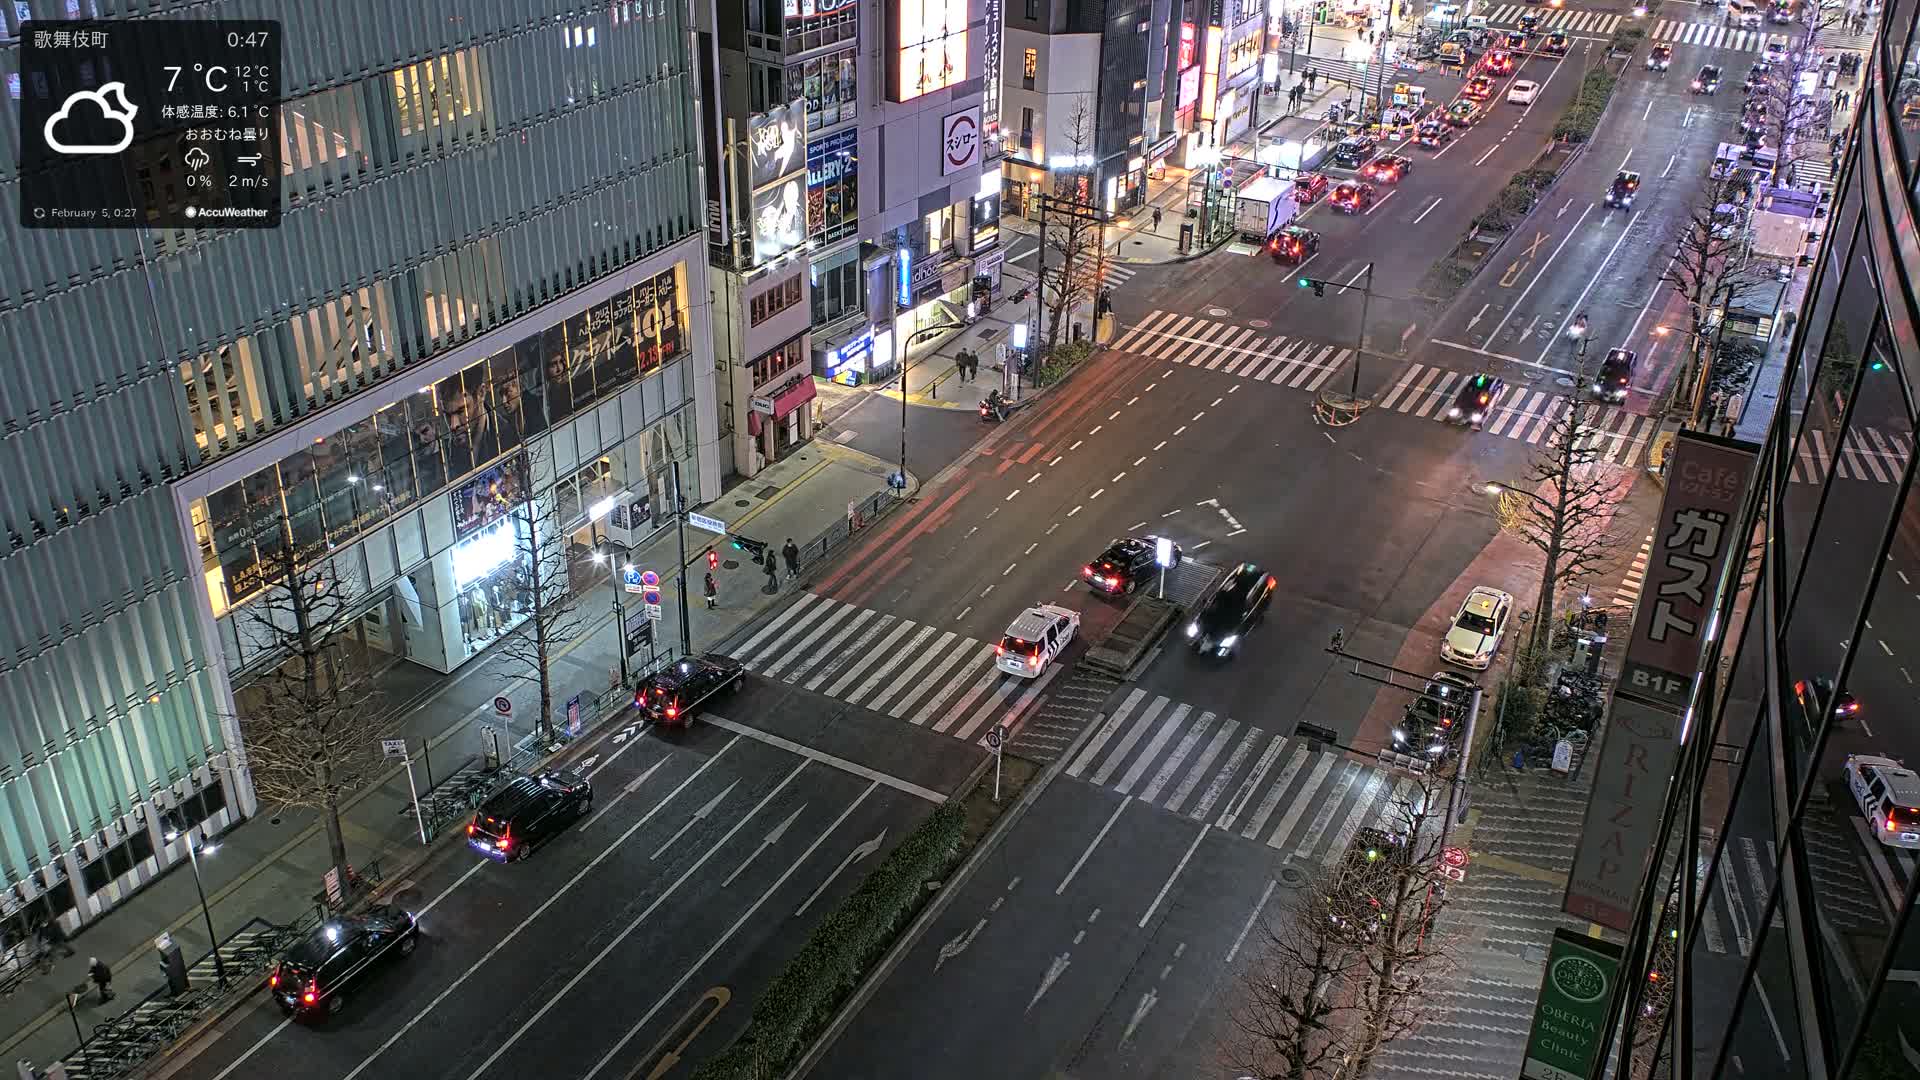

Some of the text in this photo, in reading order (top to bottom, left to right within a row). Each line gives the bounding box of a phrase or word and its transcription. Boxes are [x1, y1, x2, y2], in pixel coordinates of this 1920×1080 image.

[946, 133, 977, 152] スシロー
[708, 199, 721, 233] MUJI
[828, 224, 856, 240] BASKETBALL
[594, 305, 610, 319] クリス
[616, 295, 632, 308] マーク
[640, 344, 659, 370] 2.13
[754, 401, 769, 409] DUG
[1680, 460, 1738, 490] Café
[1648, 508, 1729, 642] ガスト
[1631, 670, 1681, 695] B1F
[1597, 742, 1650, 881] RIZAP
[1542, 1004, 1595, 1032] OBERIA
[1541, 1020, 1589, 1047] Beauty
[1541, 1038, 1584, 1061] Clinic
